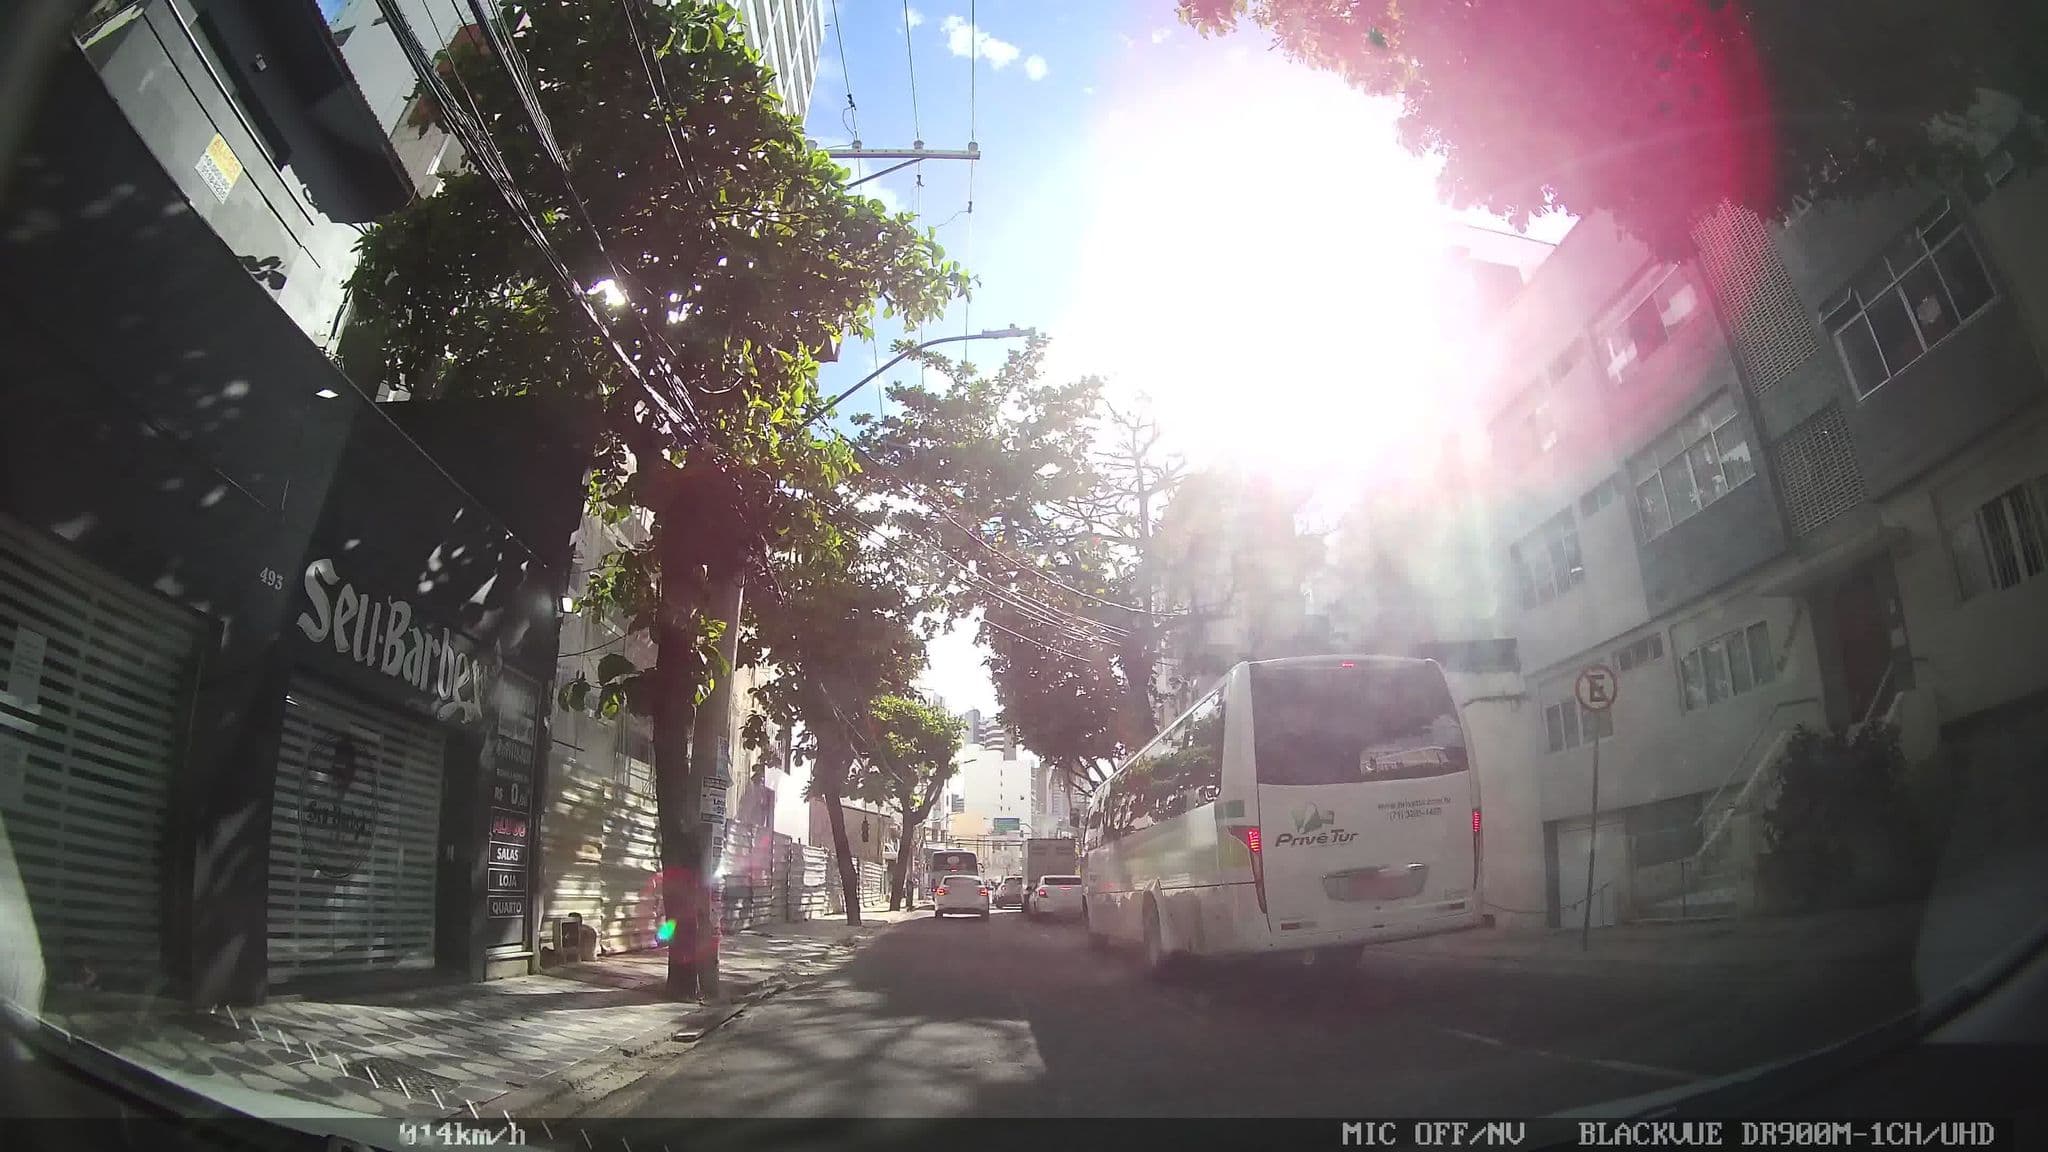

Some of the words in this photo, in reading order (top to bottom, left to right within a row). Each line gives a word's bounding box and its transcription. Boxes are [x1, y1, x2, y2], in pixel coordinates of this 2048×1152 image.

[259, 566, 285, 590] 493
[1589, 674, 1609, 703] E
[1329, 828, 1359, 844] Tur
[496, 847, 520, 862] SALAS
[499, 874, 518, 888] LOJA
[492, 901, 523, 915] QUARTO
